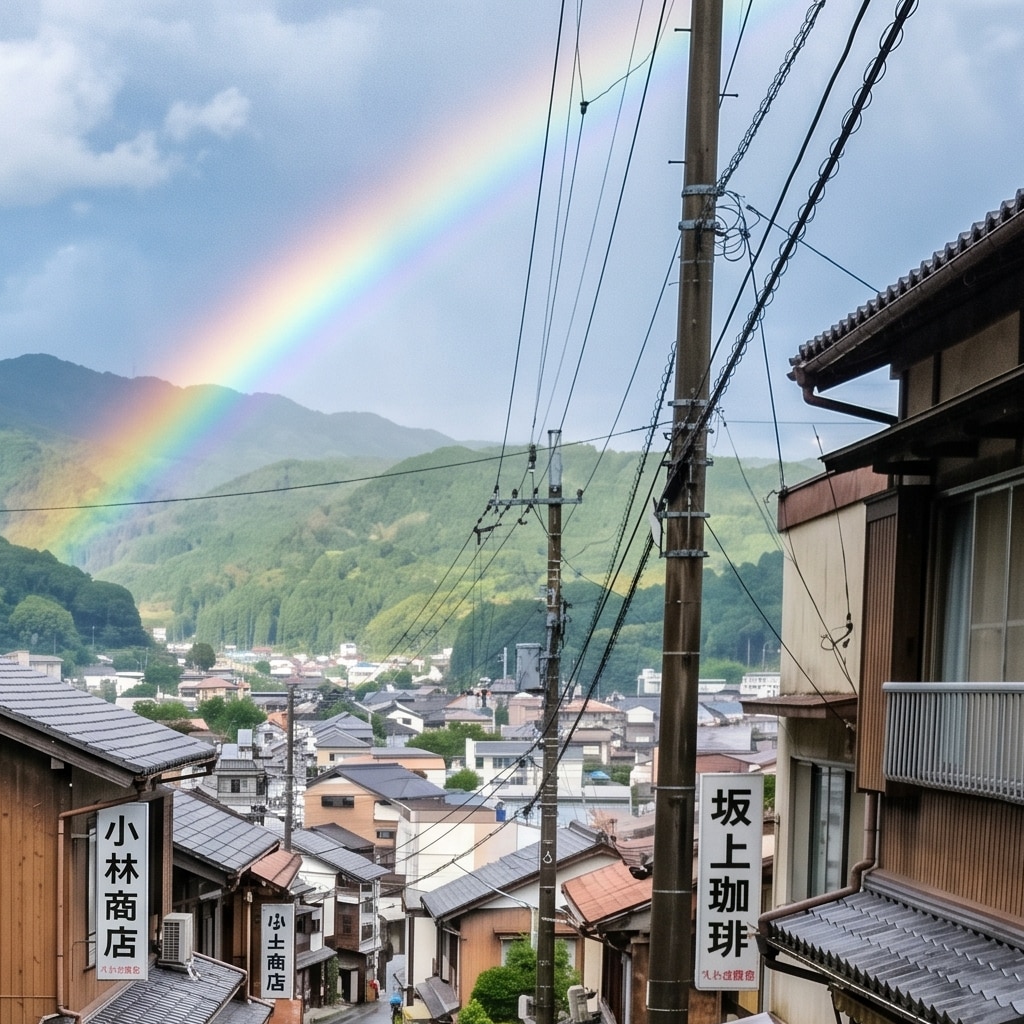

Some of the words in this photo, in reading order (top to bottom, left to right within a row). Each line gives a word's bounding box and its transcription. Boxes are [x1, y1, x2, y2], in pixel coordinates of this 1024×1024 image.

[104, 814, 140, 959] 小林商店
[707, 788, 752, 958] 坂上珈琲
